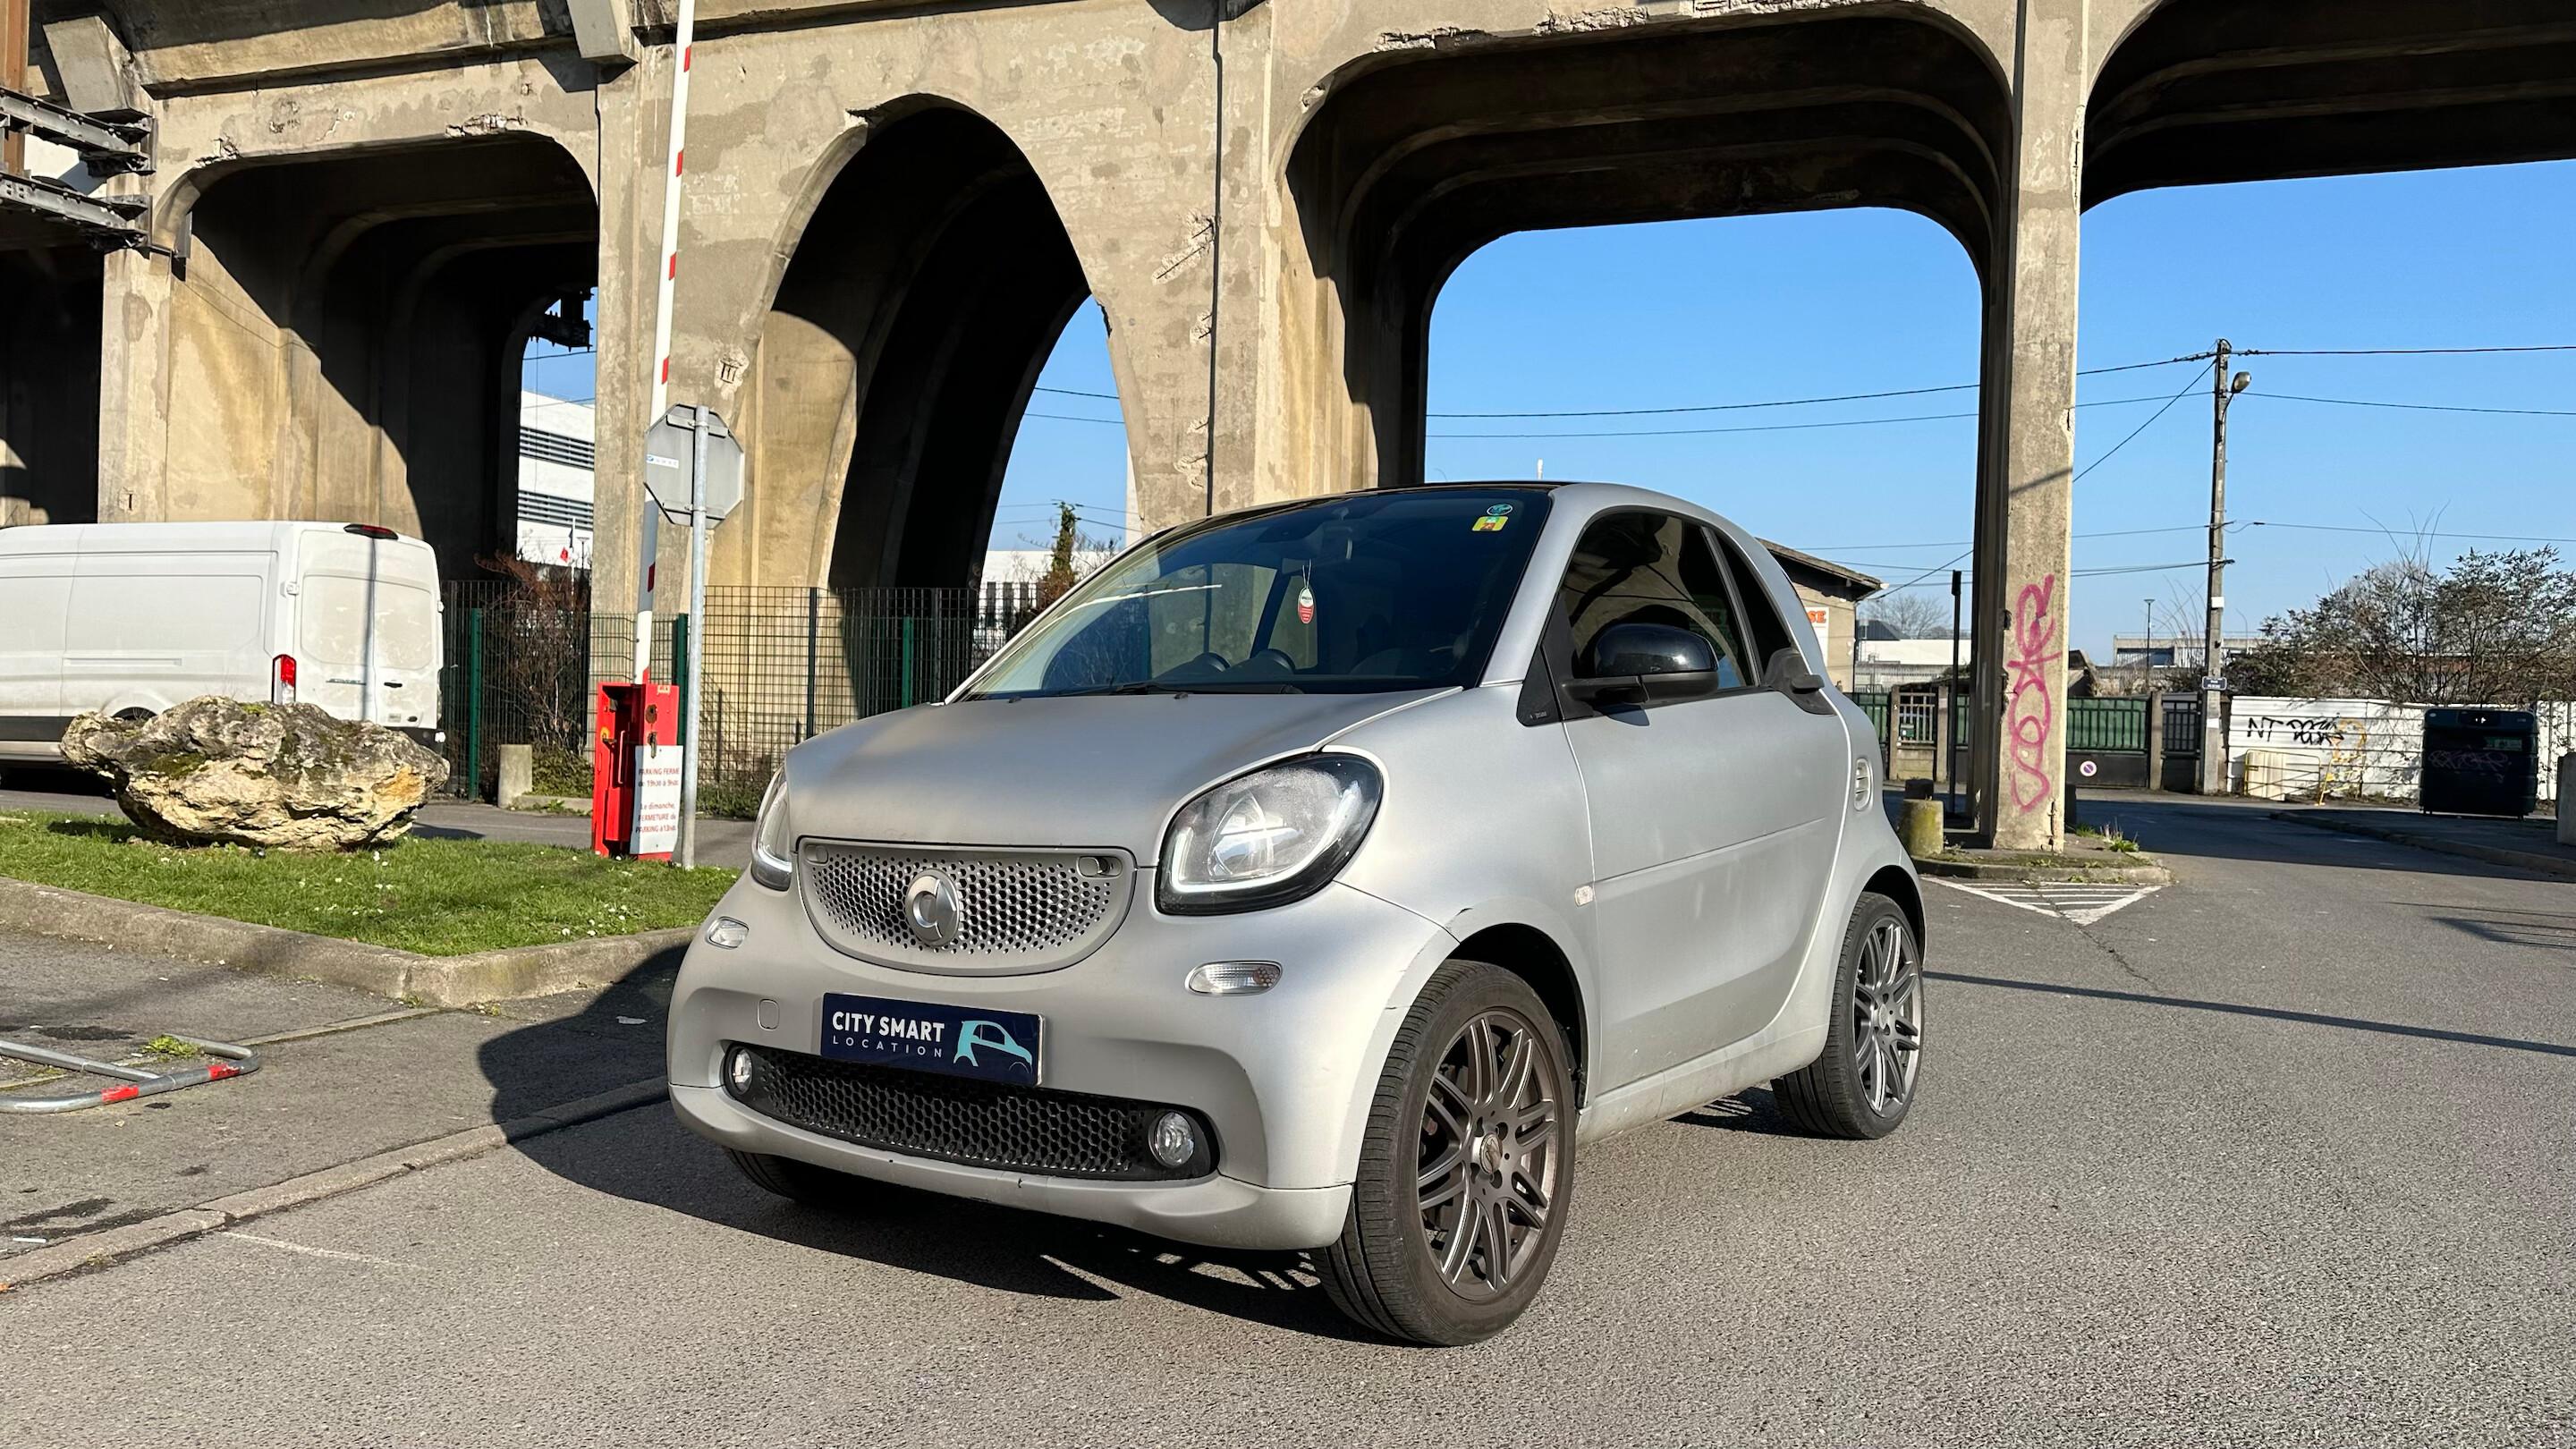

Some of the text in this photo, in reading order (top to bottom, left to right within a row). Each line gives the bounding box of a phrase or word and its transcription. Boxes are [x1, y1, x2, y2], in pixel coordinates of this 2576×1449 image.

[638, 767, 662, 775] PARKING
[638, 813, 669, 821] FERMETURE
[635, 825, 658, 834] PARKING
[832, 1011, 945, 1043] CITY SMART
[833, 1035, 942, 1058] LOCATION
